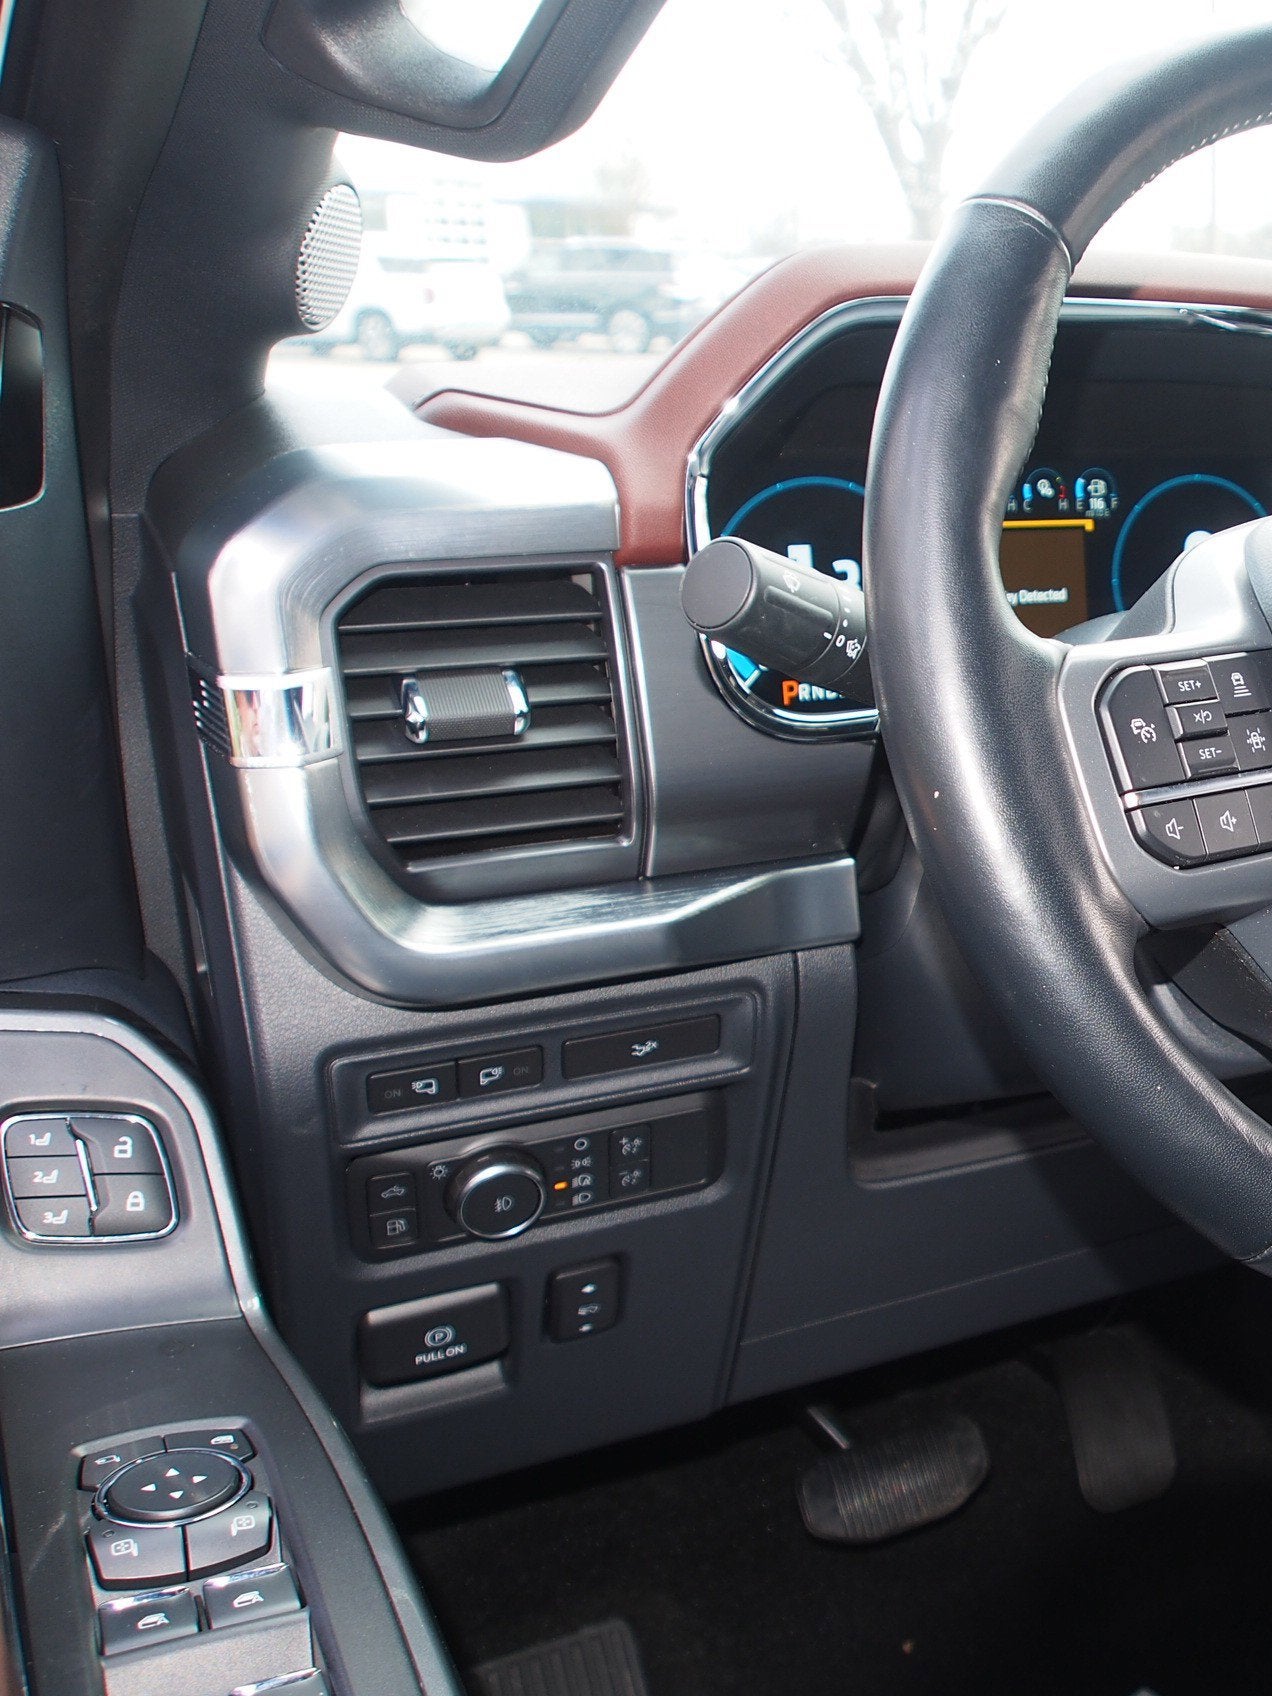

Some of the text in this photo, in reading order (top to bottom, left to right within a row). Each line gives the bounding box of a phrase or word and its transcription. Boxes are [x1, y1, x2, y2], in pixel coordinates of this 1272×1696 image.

[1058, 498, 1069, 511] H
[1076, 498, 1084, 510] E
[1018, 588, 1068, 605] Detected
[1177, 680, 1202, 692] SET+
[1198, 748, 1222, 760] SET-
[513, 1066, 529, 1076] ON
[384, 1089, 402, 1100] ON
[414, 1345, 465, 1365] PULL ON
